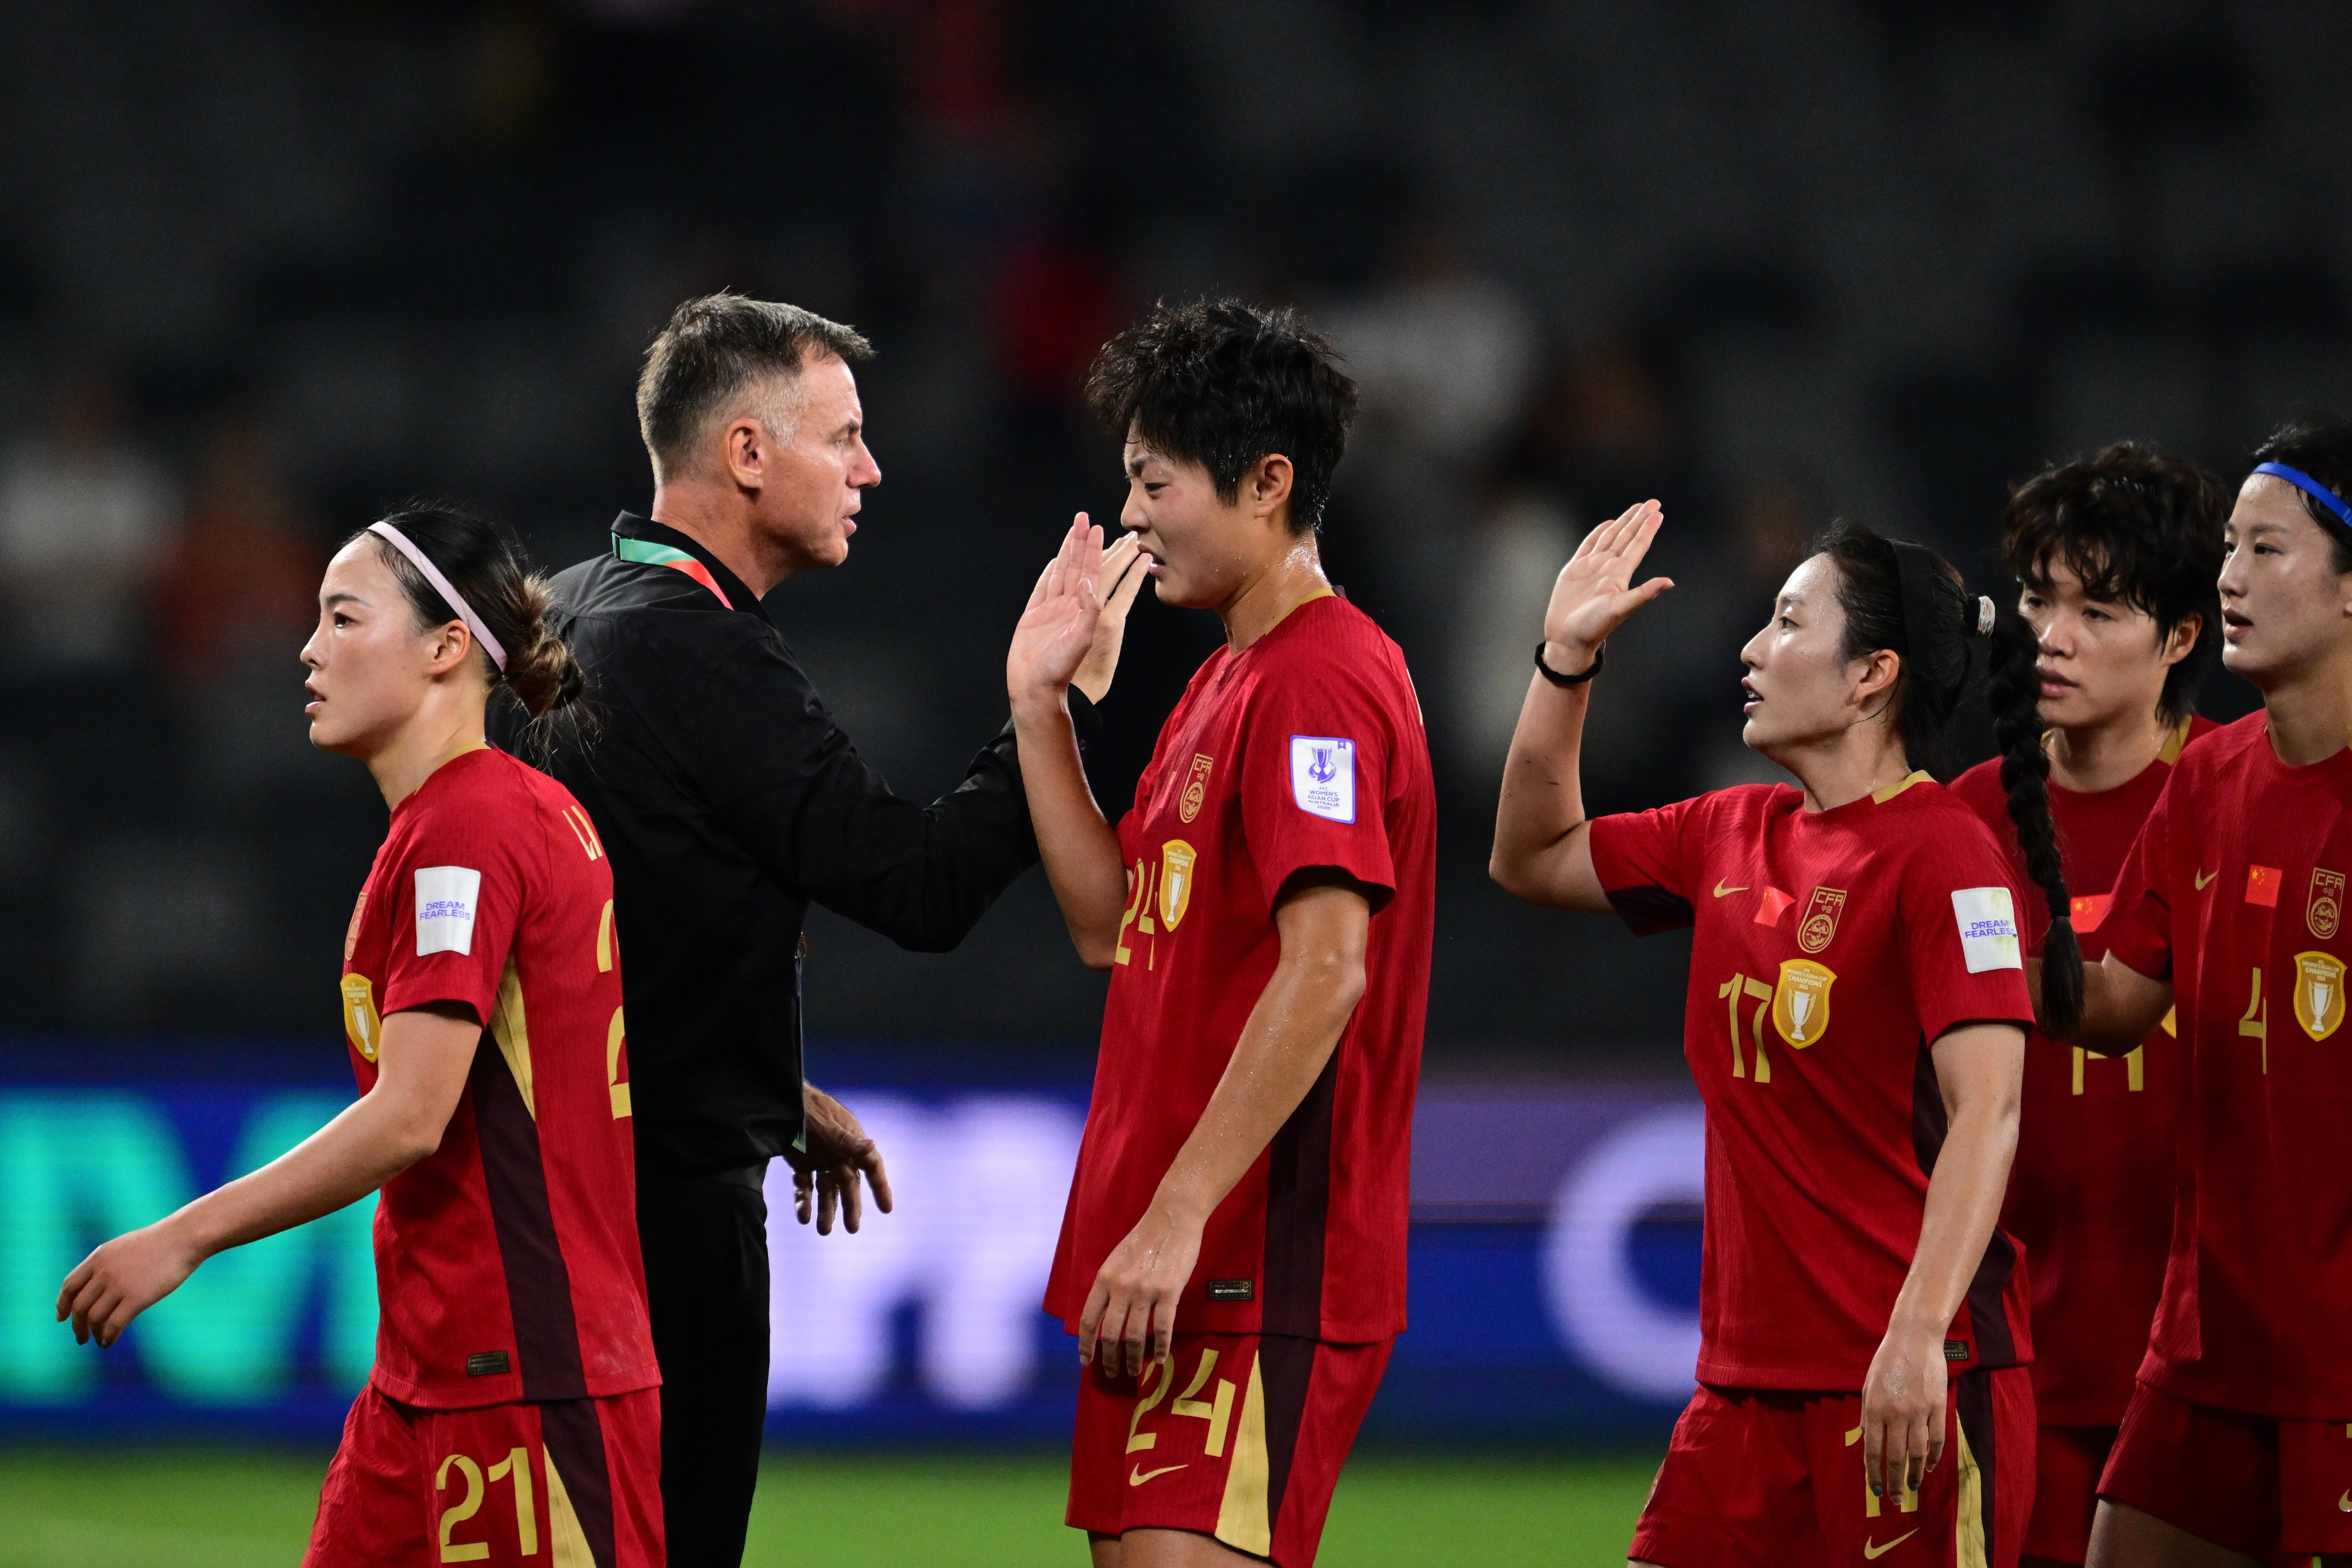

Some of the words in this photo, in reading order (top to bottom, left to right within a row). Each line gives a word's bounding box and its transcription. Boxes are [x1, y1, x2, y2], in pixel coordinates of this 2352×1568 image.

[1194, 759, 1211, 774] CFA
[2315, 872, 2343, 890] CFA
[426, 901, 465, 911] DREAM
[1815, 891, 1844, 906] CFA
[419, 909, 470, 921] FEARLESS
[1971, 920, 2009, 930] DREAM
[1964, 927, 2015, 939] FEARLESS
[1786, 968, 1805, 976] WOMEN'S
[1789, 975, 1822, 988] CHAMPIONS
[1718, 972, 1773, 1083] 17
[2239, 967, 2267, 1075] 4
[1125, 1348, 1236, 1458] 24
[435, 1447, 538, 1563] 21
